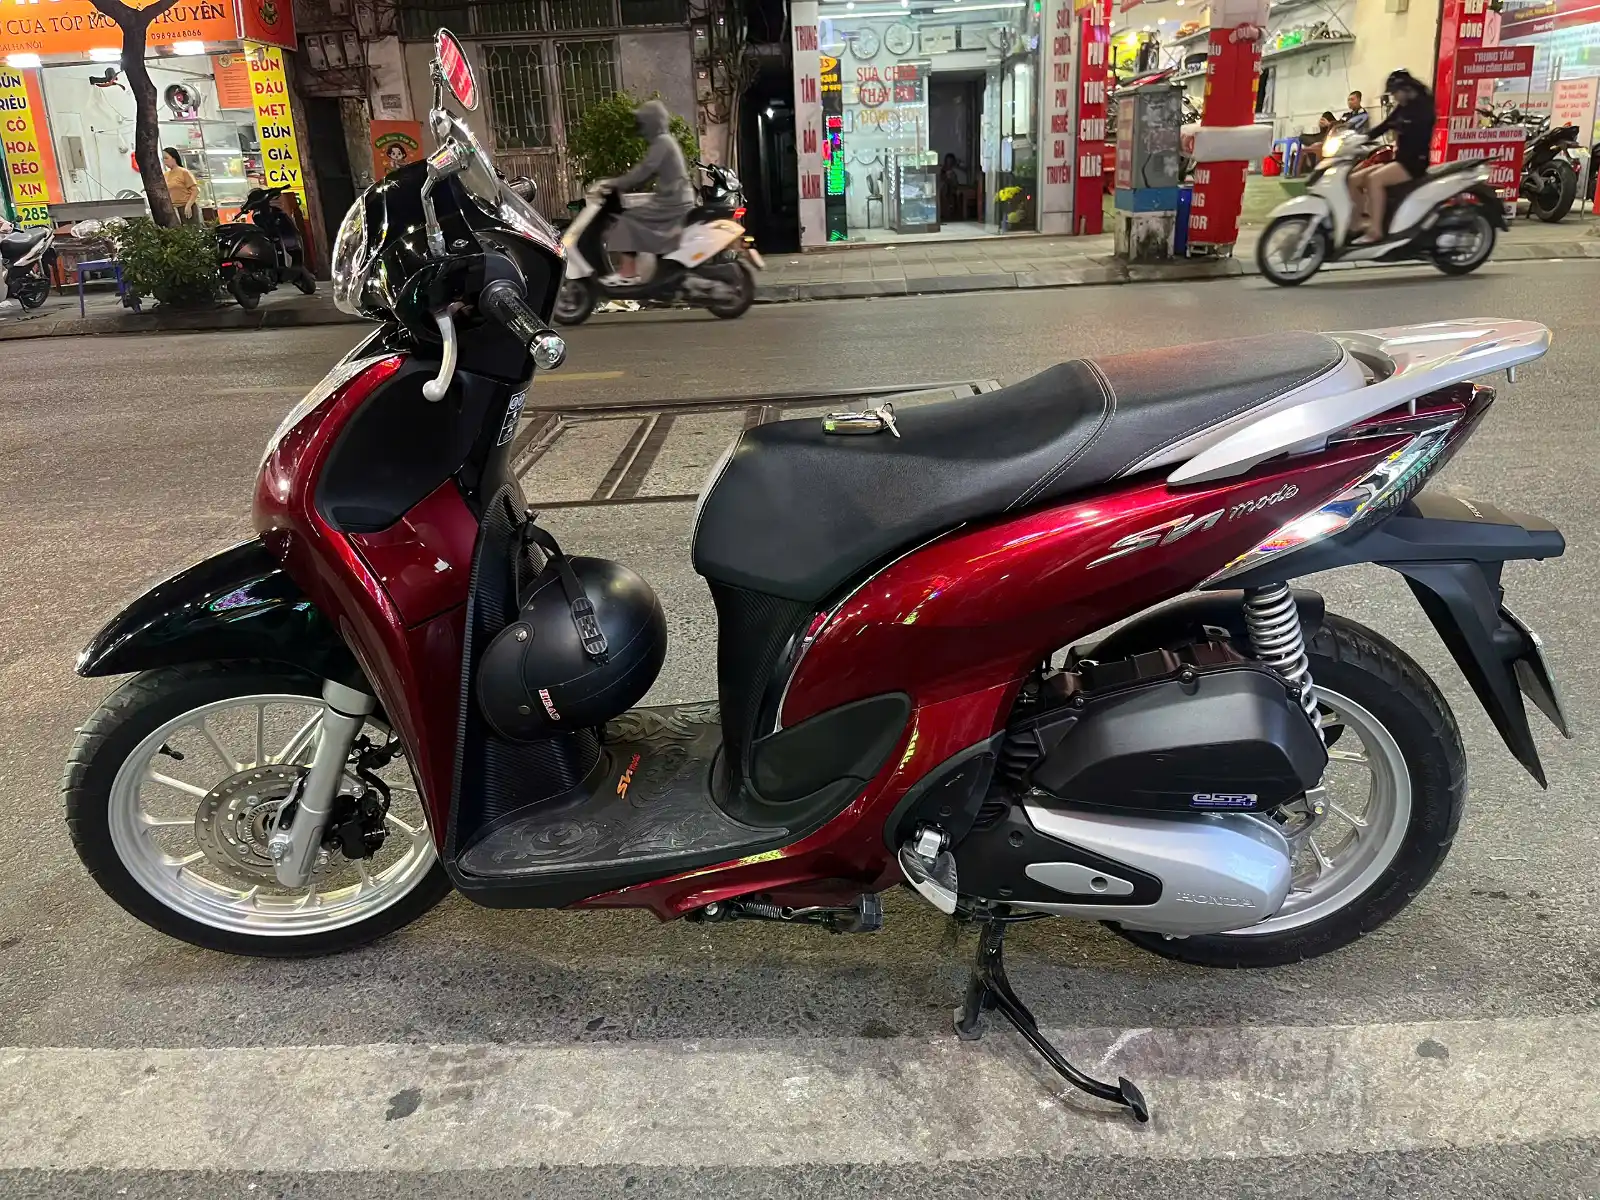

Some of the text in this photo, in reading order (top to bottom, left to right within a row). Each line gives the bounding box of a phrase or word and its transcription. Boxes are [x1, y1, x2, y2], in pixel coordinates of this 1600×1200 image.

[6, 18, 47, 35] CUA
[49, 12, 83, 32] TÓP
[255, 78, 284, 97] ĐẬU
[259, 104, 286, 119] MẸT
[6, 116, 27, 132] CÔ
[262, 122, 291, 138] BÚN
[1499, 129, 1522, 138] MOTOR
[6, 142, 36, 154] HOA
[1457, 148, 1485, 161] MUA
[12, 160, 39, 175] BÉO
[1488, 166, 1514, 184] HỮA
[19, 184, 43, 198] XỊN
[22, 207, 49, 222] 285
[1228, 483, 1299, 522] mode
[1176, 892, 1256, 908] HONDA
